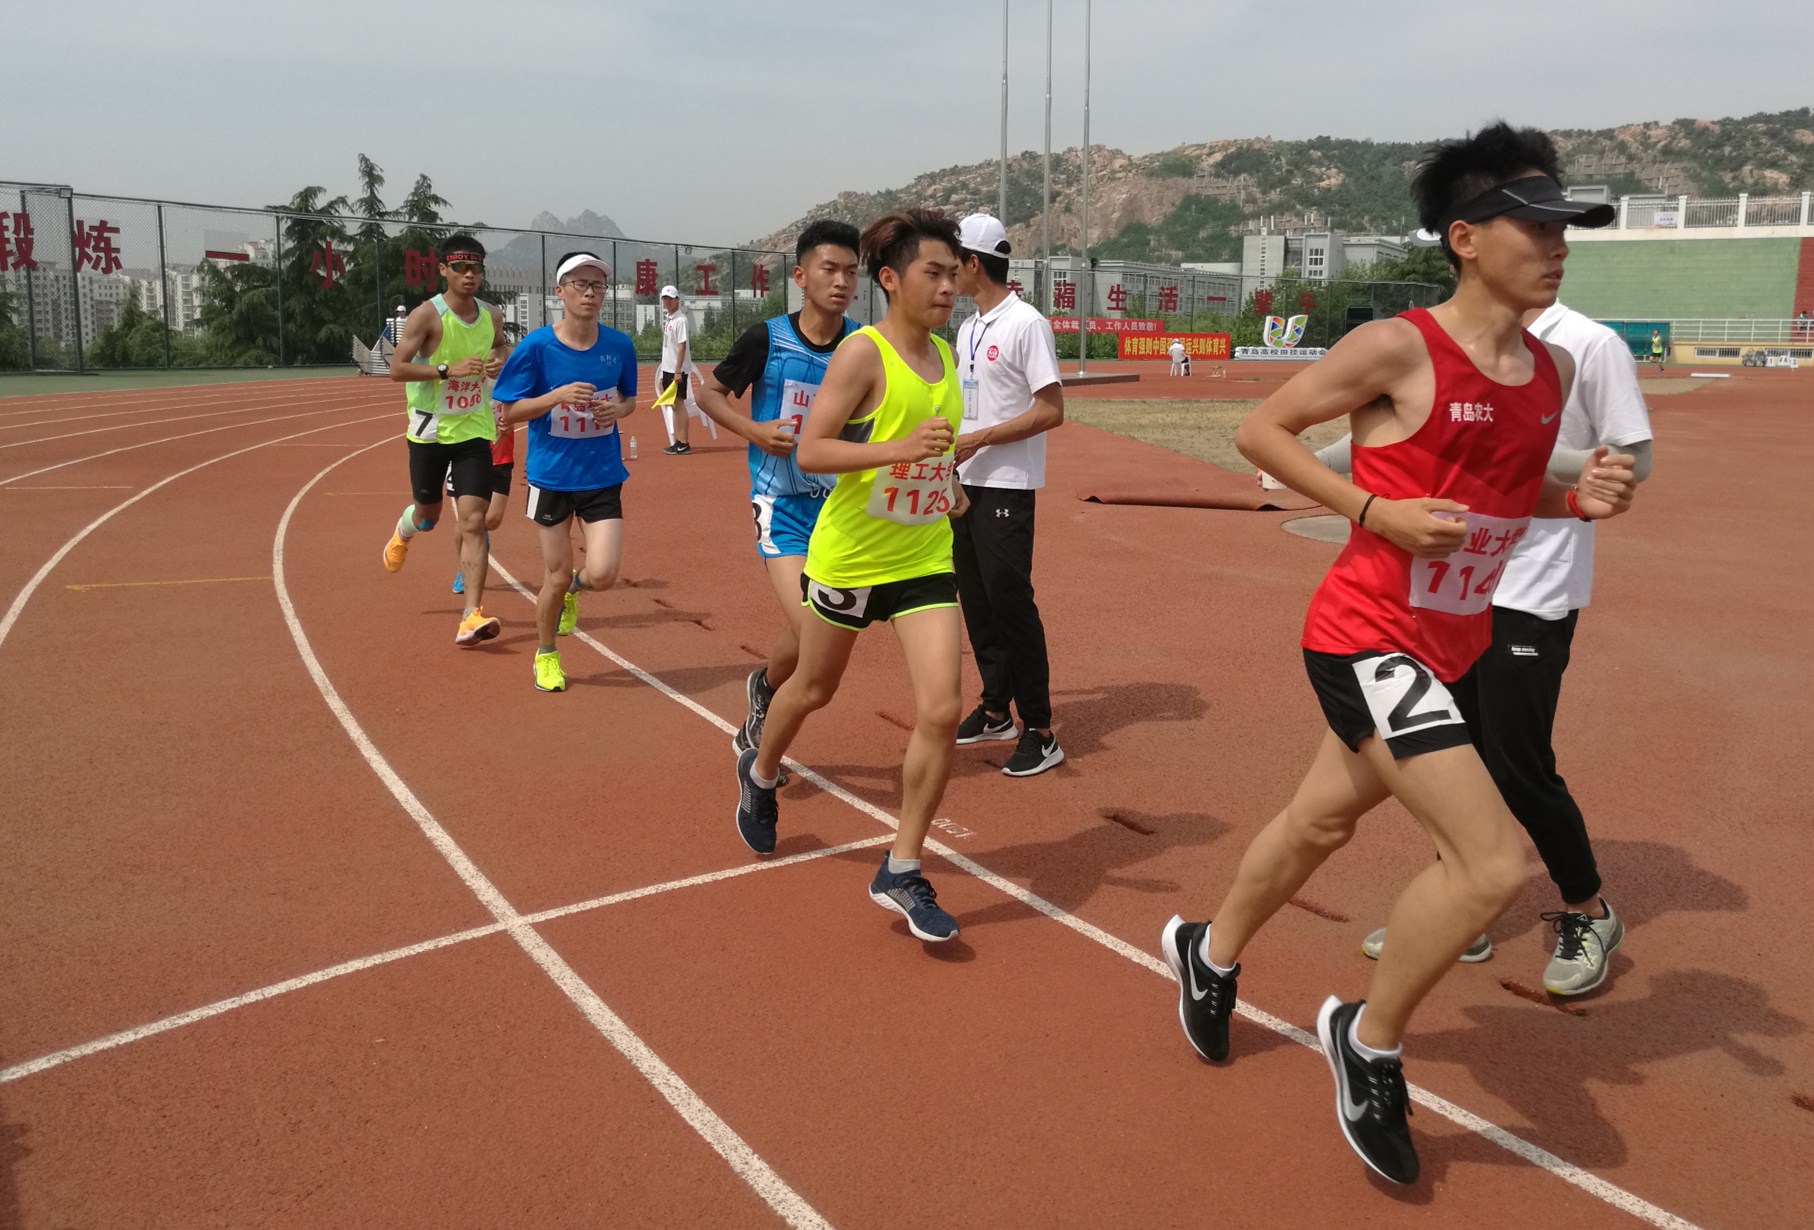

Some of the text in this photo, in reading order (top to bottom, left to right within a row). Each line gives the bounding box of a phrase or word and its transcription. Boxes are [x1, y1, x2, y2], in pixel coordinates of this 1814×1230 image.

[415, 409, 433, 437] 7
[560, 415, 613, 432] 111
[1449, 402, 1494, 422] 青岛农大
[883, 487, 950, 515] 1125
[1427, 560, 1503, 600] 114
[1375, 656, 1452, 732] 2
